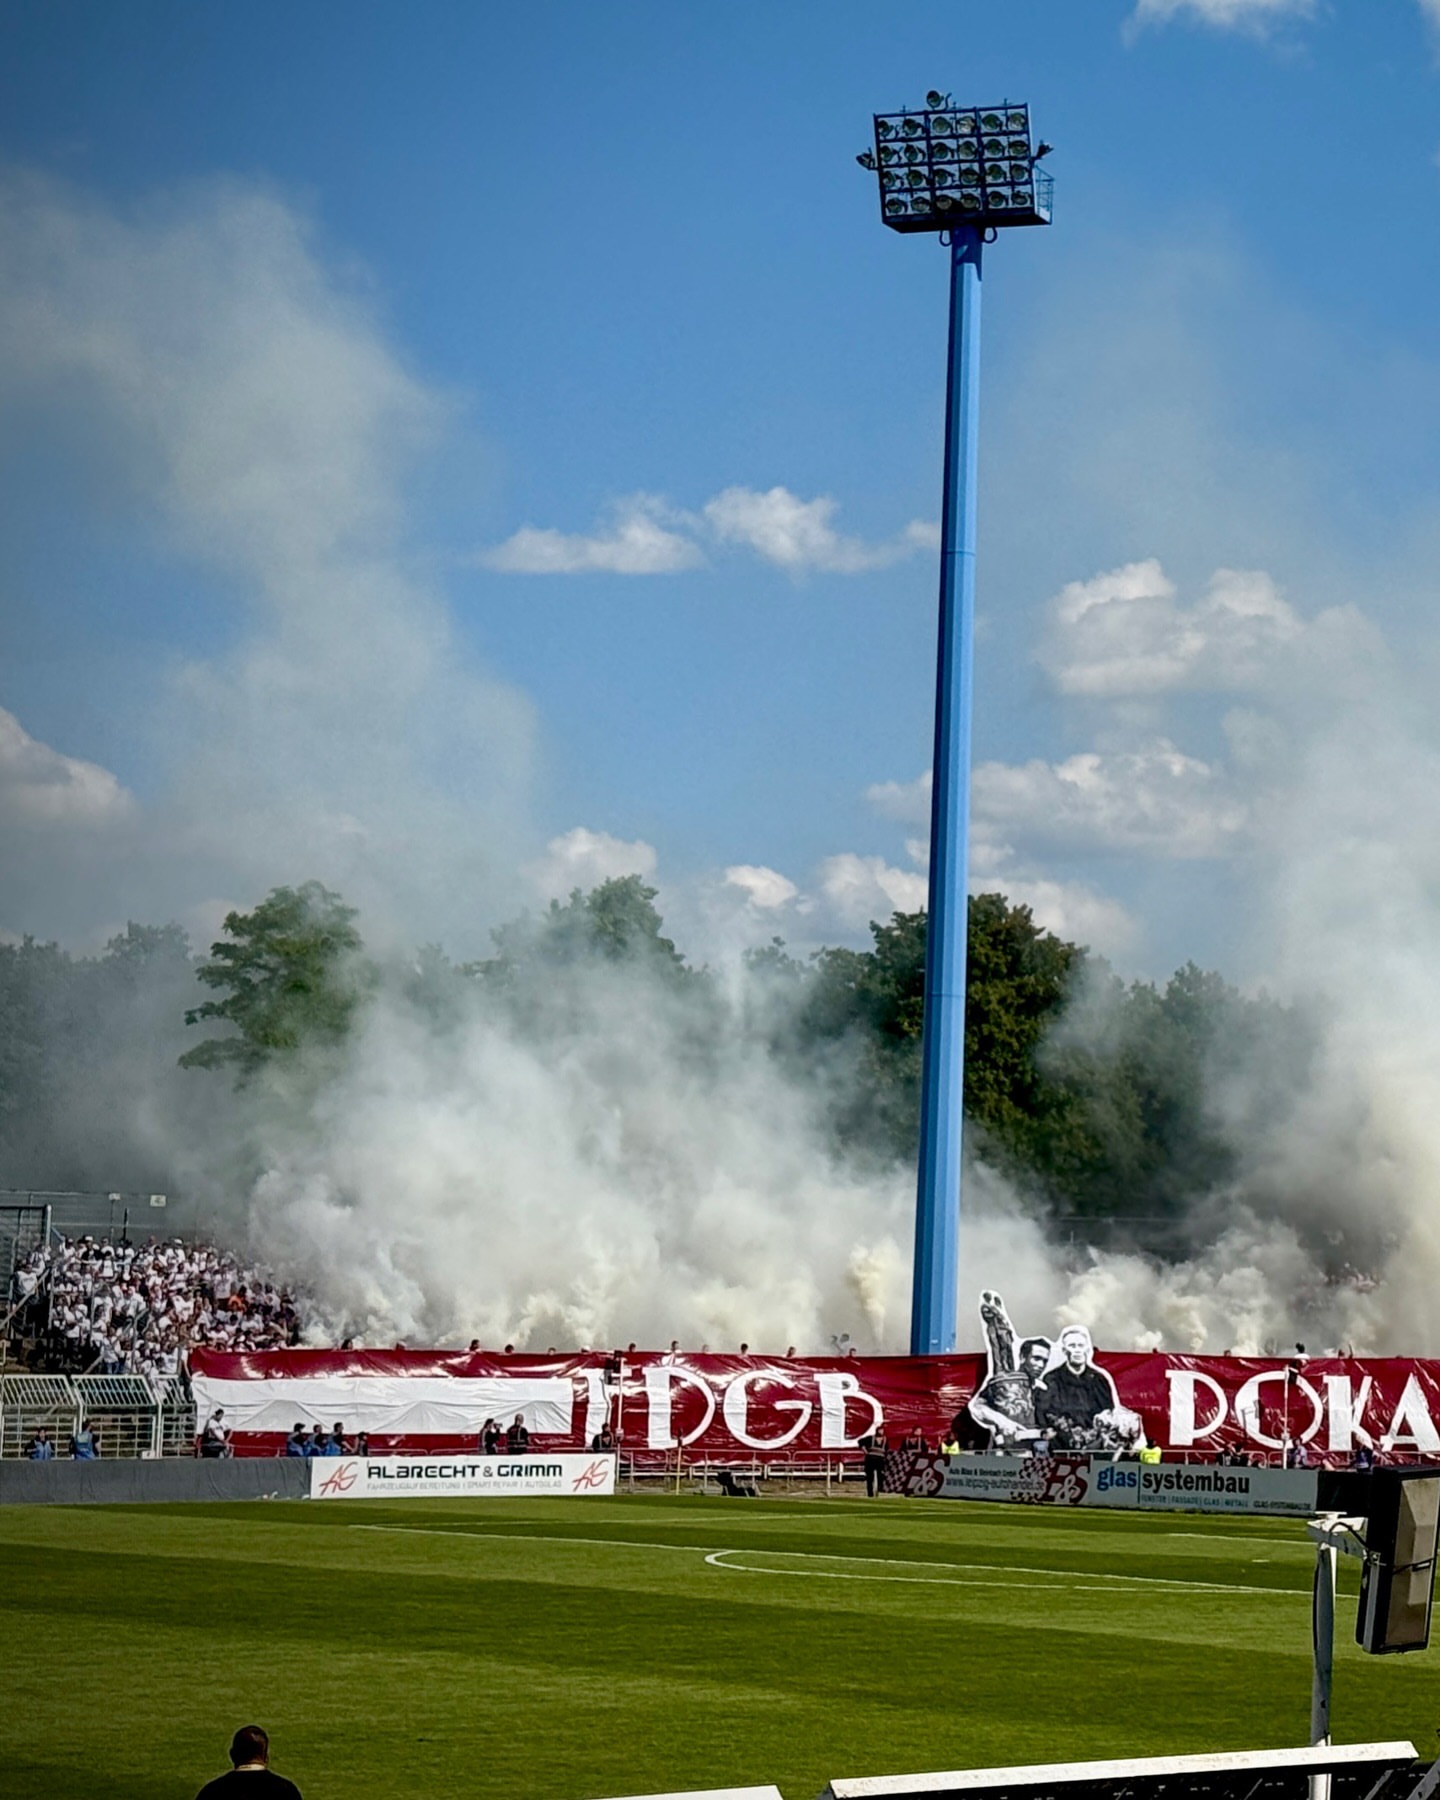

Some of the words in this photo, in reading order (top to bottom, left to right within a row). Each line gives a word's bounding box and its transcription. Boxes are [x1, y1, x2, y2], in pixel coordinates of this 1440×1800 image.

[368, 1465, 480, 1478] ALBRECHT
[483, 1466, 493, 1477] &
[497, 1465, 562, 1477] GRIMM
[1097, 1467, 1137, 1491] glas
[1142, 1469, 1249, 1493] systembau
